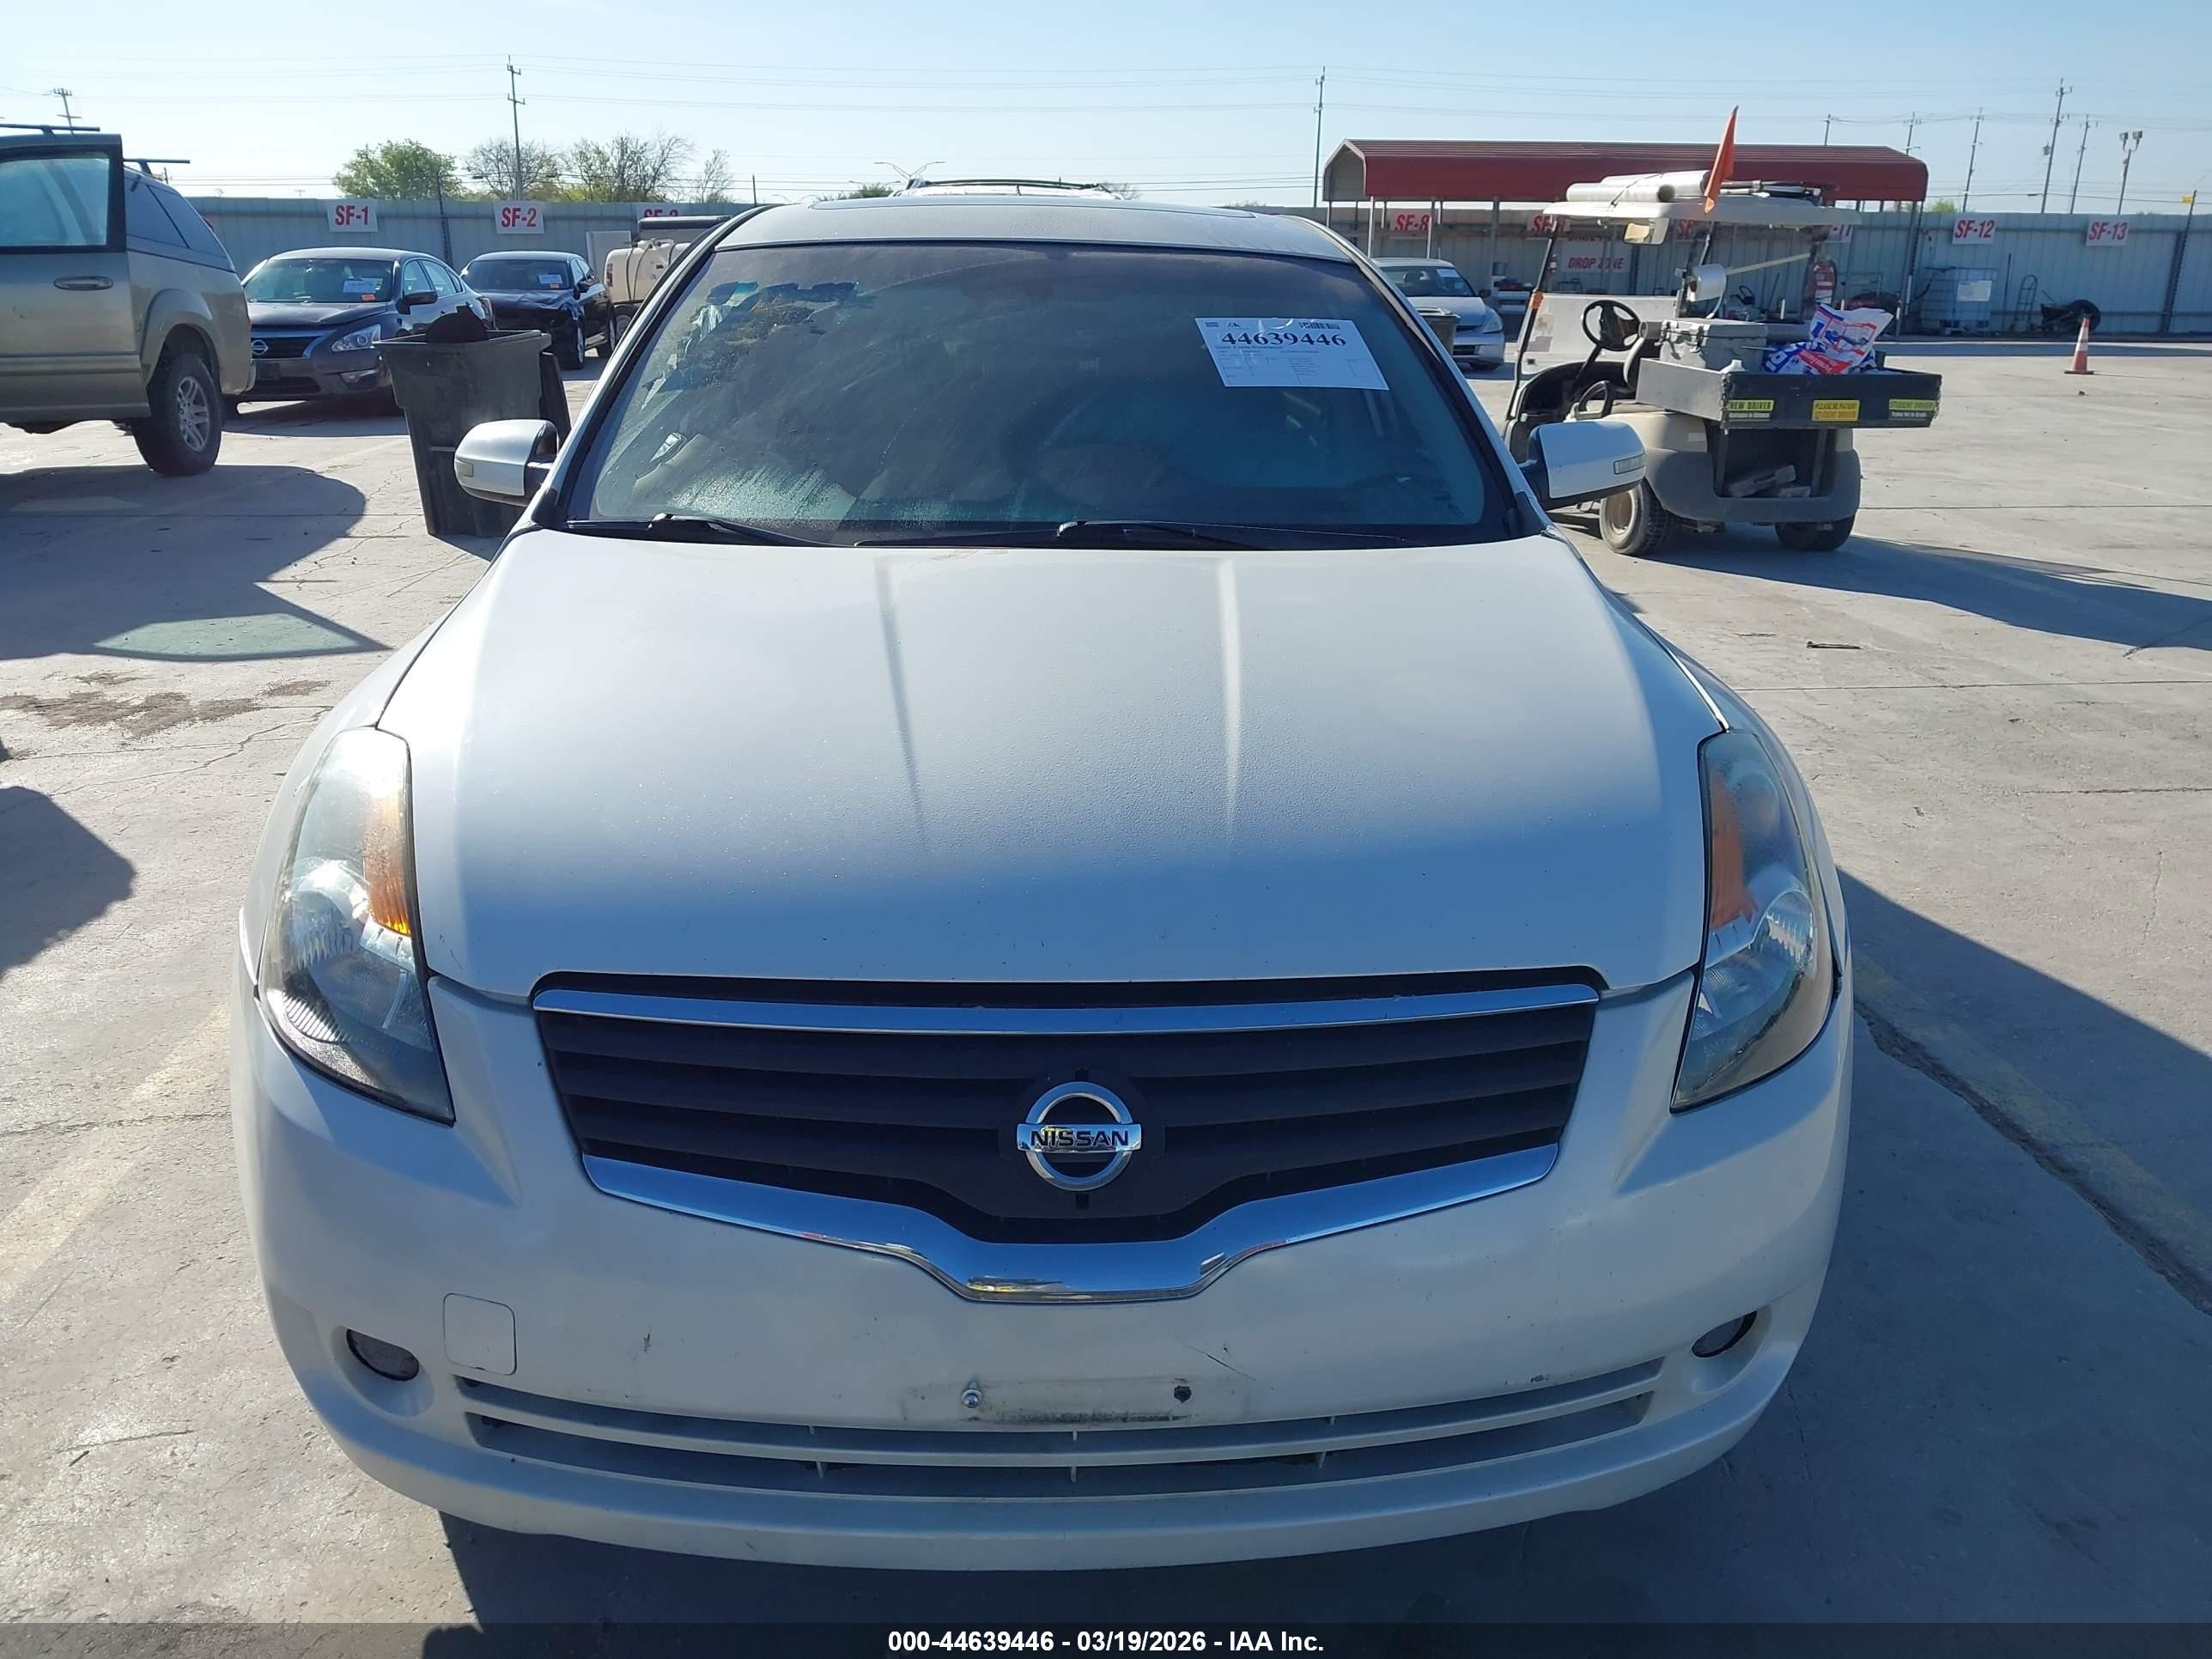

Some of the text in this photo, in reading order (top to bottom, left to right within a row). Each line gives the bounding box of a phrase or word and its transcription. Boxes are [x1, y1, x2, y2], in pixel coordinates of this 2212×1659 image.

[335, 205, 369, 226] SF-1
[501, 207, 537, 228] SF-2
[1395, 215, 1430, 231] SF-8
[1954, 220, 1995, 239] SF-12
[2088, 222, 2128, 240] SF-13
[1568, 257, 1595, 269] DROP
[1222, 331, 1346, 346] 44639446
[1030, 1130, 1129, 1146] NISSAN
